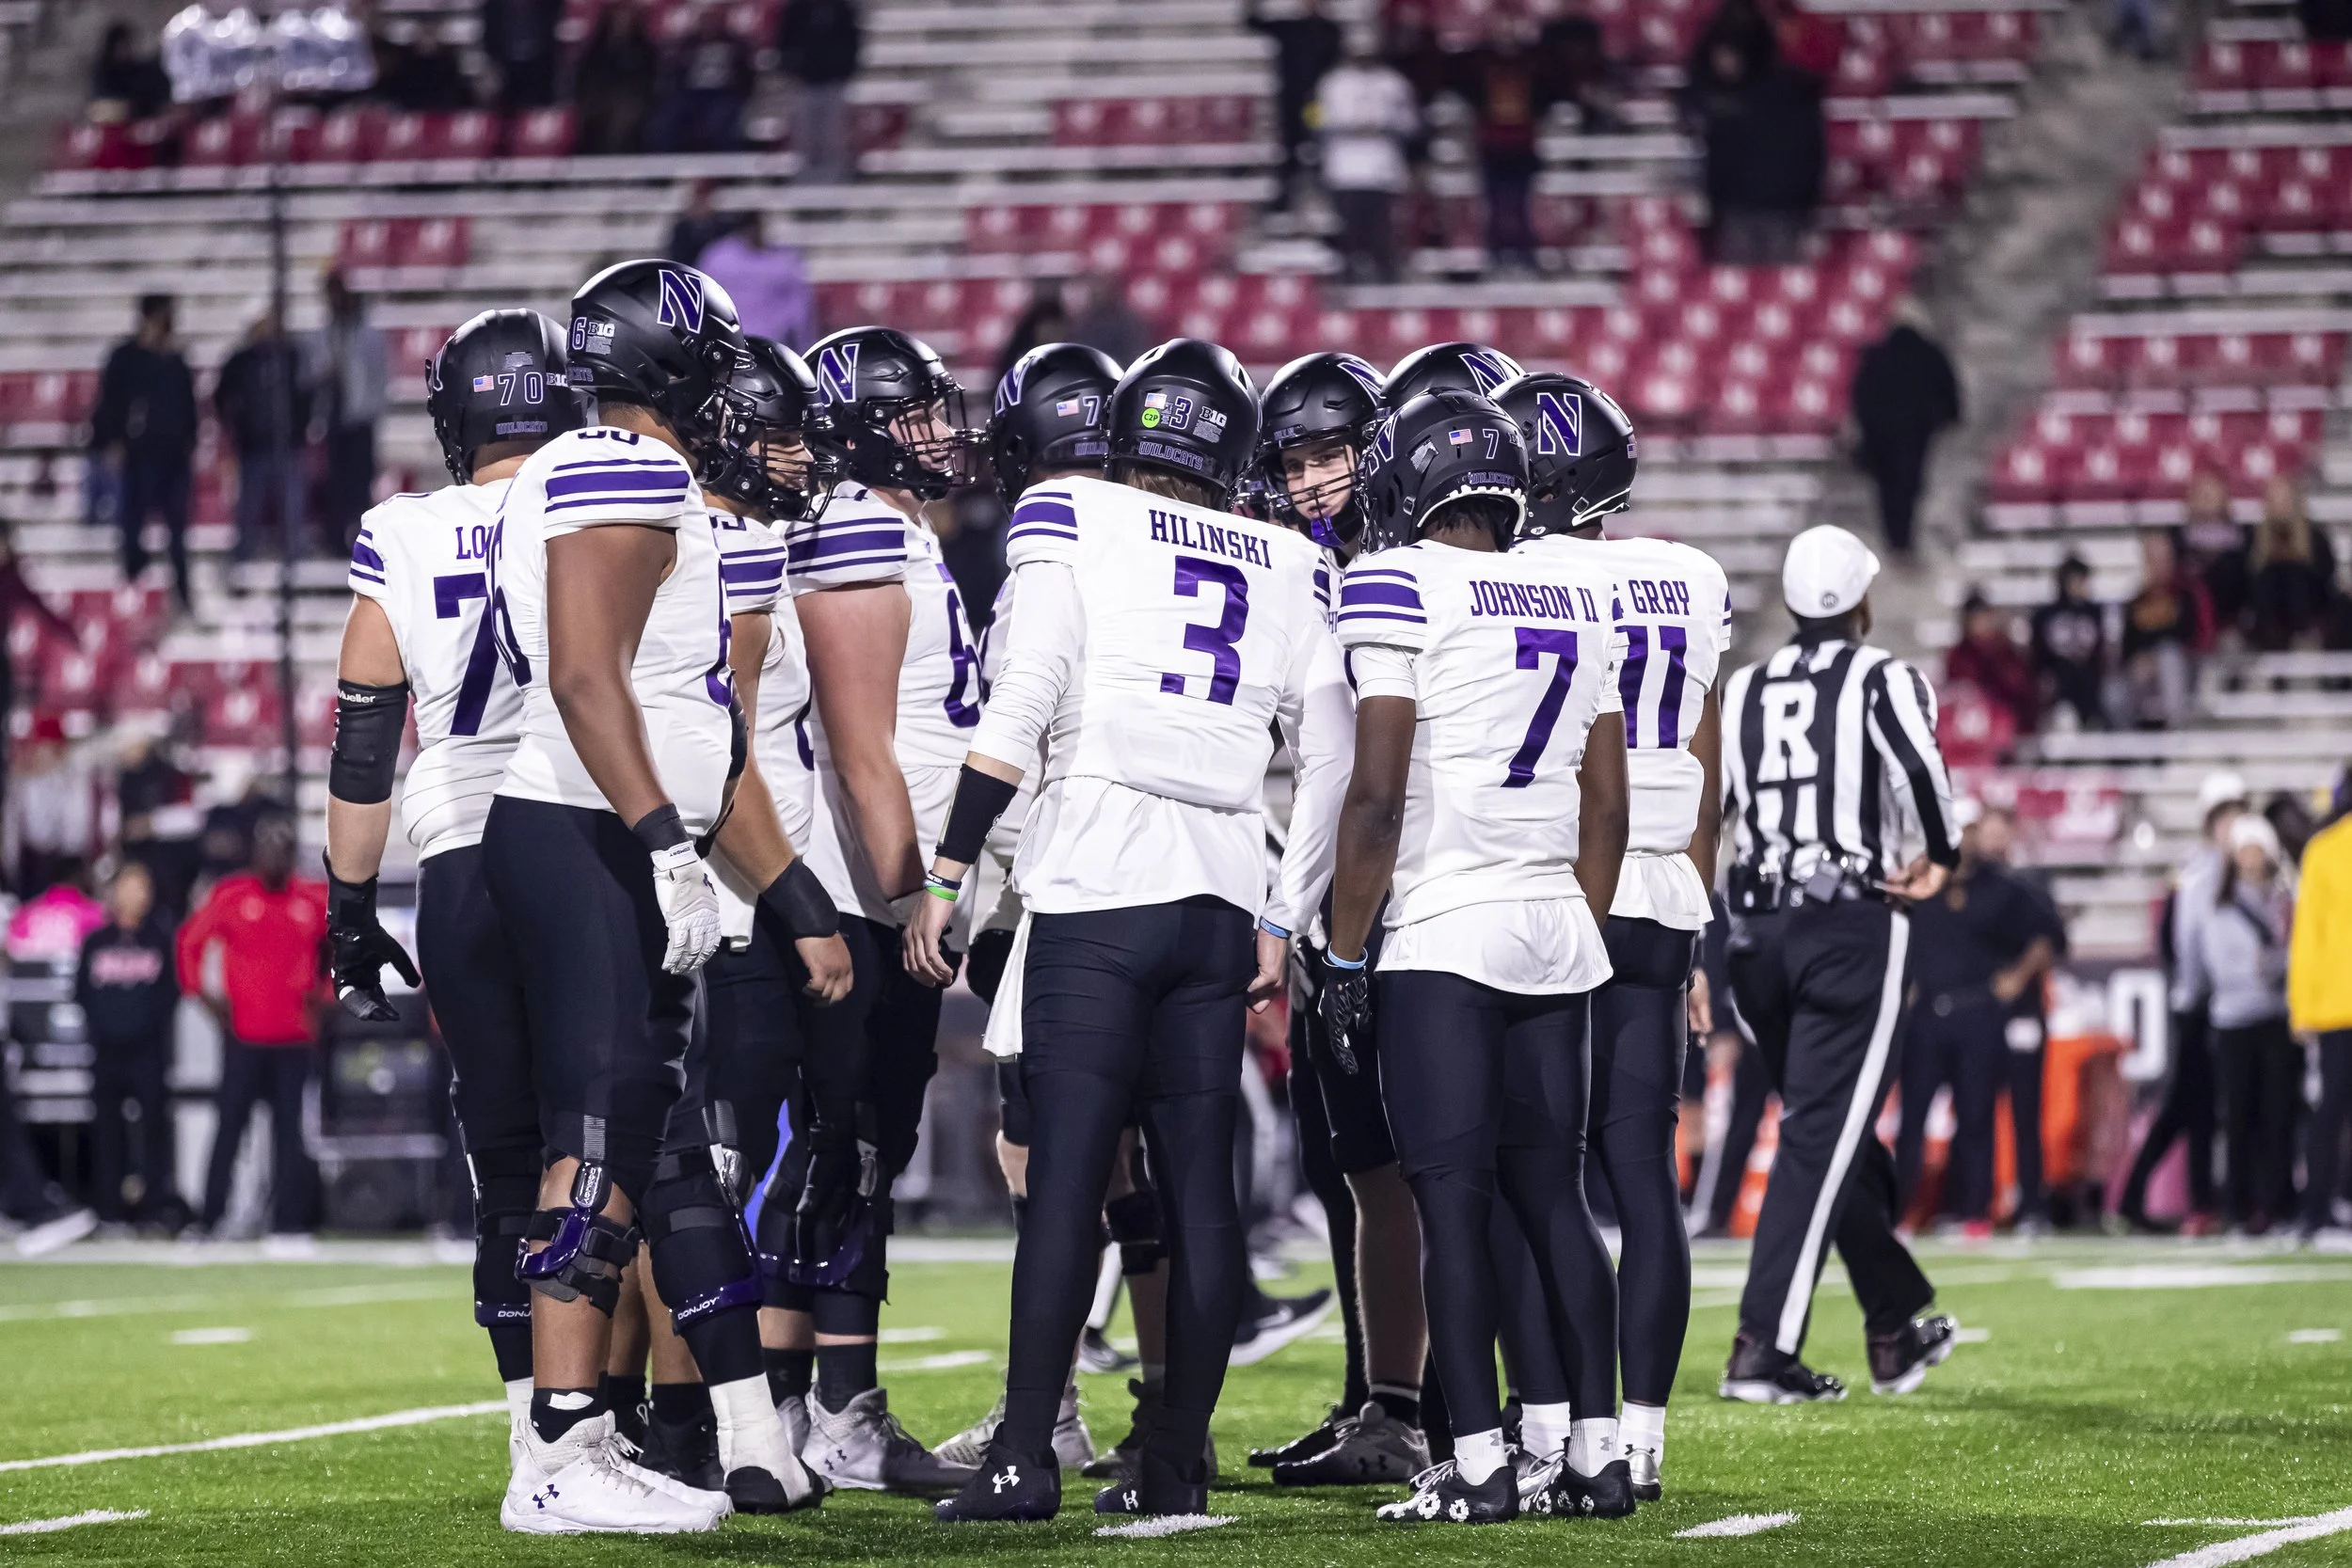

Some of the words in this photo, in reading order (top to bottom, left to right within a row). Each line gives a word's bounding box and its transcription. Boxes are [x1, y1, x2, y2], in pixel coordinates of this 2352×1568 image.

[657, 269, 706, 334] N
[497, 372, 544, 406] 70
[816, 342, 860, 408] N
[1144, 413, 1159, 422] C2P
[1168, 396, 1193, 430] 3
[1536, 392, 1581, 457] N
[1138, 440, 1203, 470] WILDCATS
[1482, 428, 1500, 460] 7
[1149, 509, 1272, 570] HILINSKI
[1469, 579, 1576, 621] JOHNSON
[1576, 587, 1599, 623] II
[1628, 579, 1691, 616] GRAY
[1159, 555, 1249, 705] 3
[1500, 626, 1578, 788] 7
[1756, 679, 1819, 783] R
[677, 1296, 720, 1321] DONJOY
